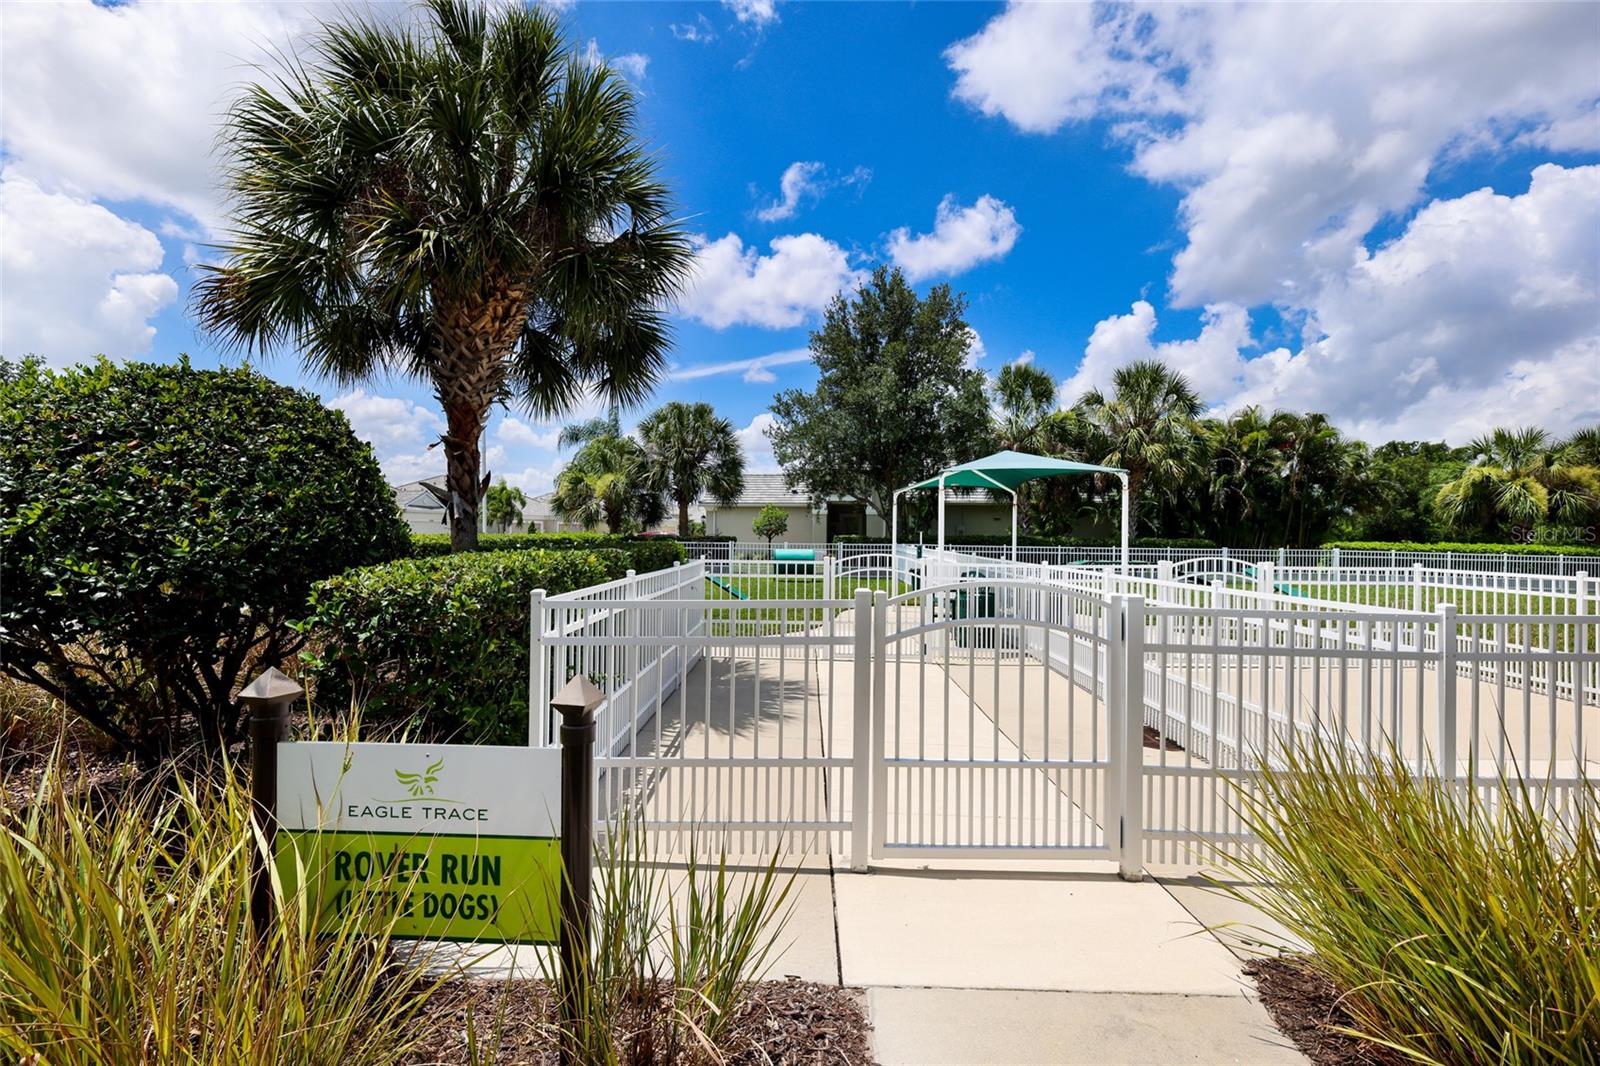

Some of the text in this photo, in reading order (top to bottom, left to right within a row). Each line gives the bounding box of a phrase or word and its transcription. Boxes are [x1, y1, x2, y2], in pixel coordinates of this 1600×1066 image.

[348, 805, 489, 821] EAGLE TRACE
[334, 850, 501, 886] ROVER RUN
[423, 891, 499, 925] DOGS)
